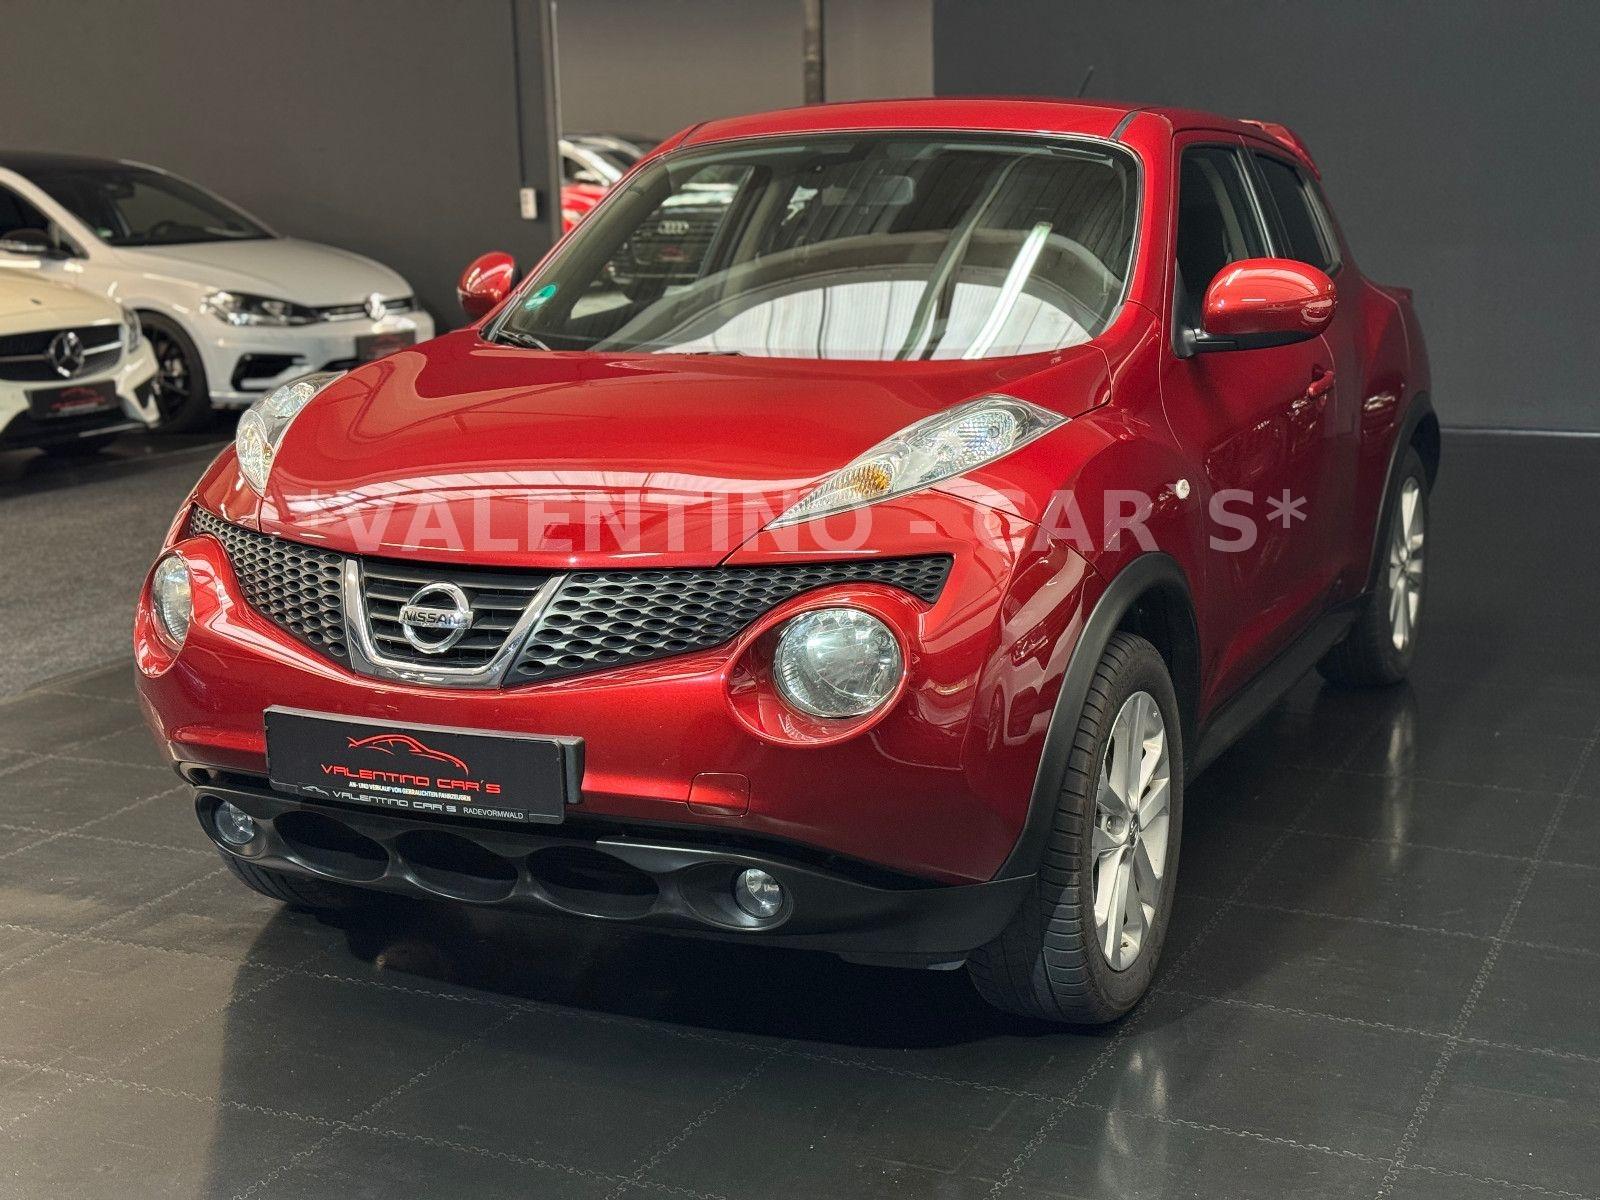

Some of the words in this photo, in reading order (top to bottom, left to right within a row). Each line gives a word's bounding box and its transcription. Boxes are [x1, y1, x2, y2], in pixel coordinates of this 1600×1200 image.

[402, 610, 469, 626] NISSAN
[320, 763, 430, 787] VALENTINO
[332, 790, 409, 808] VALENTINO
[462, 806, 524, 820] RADEVORMWALD
